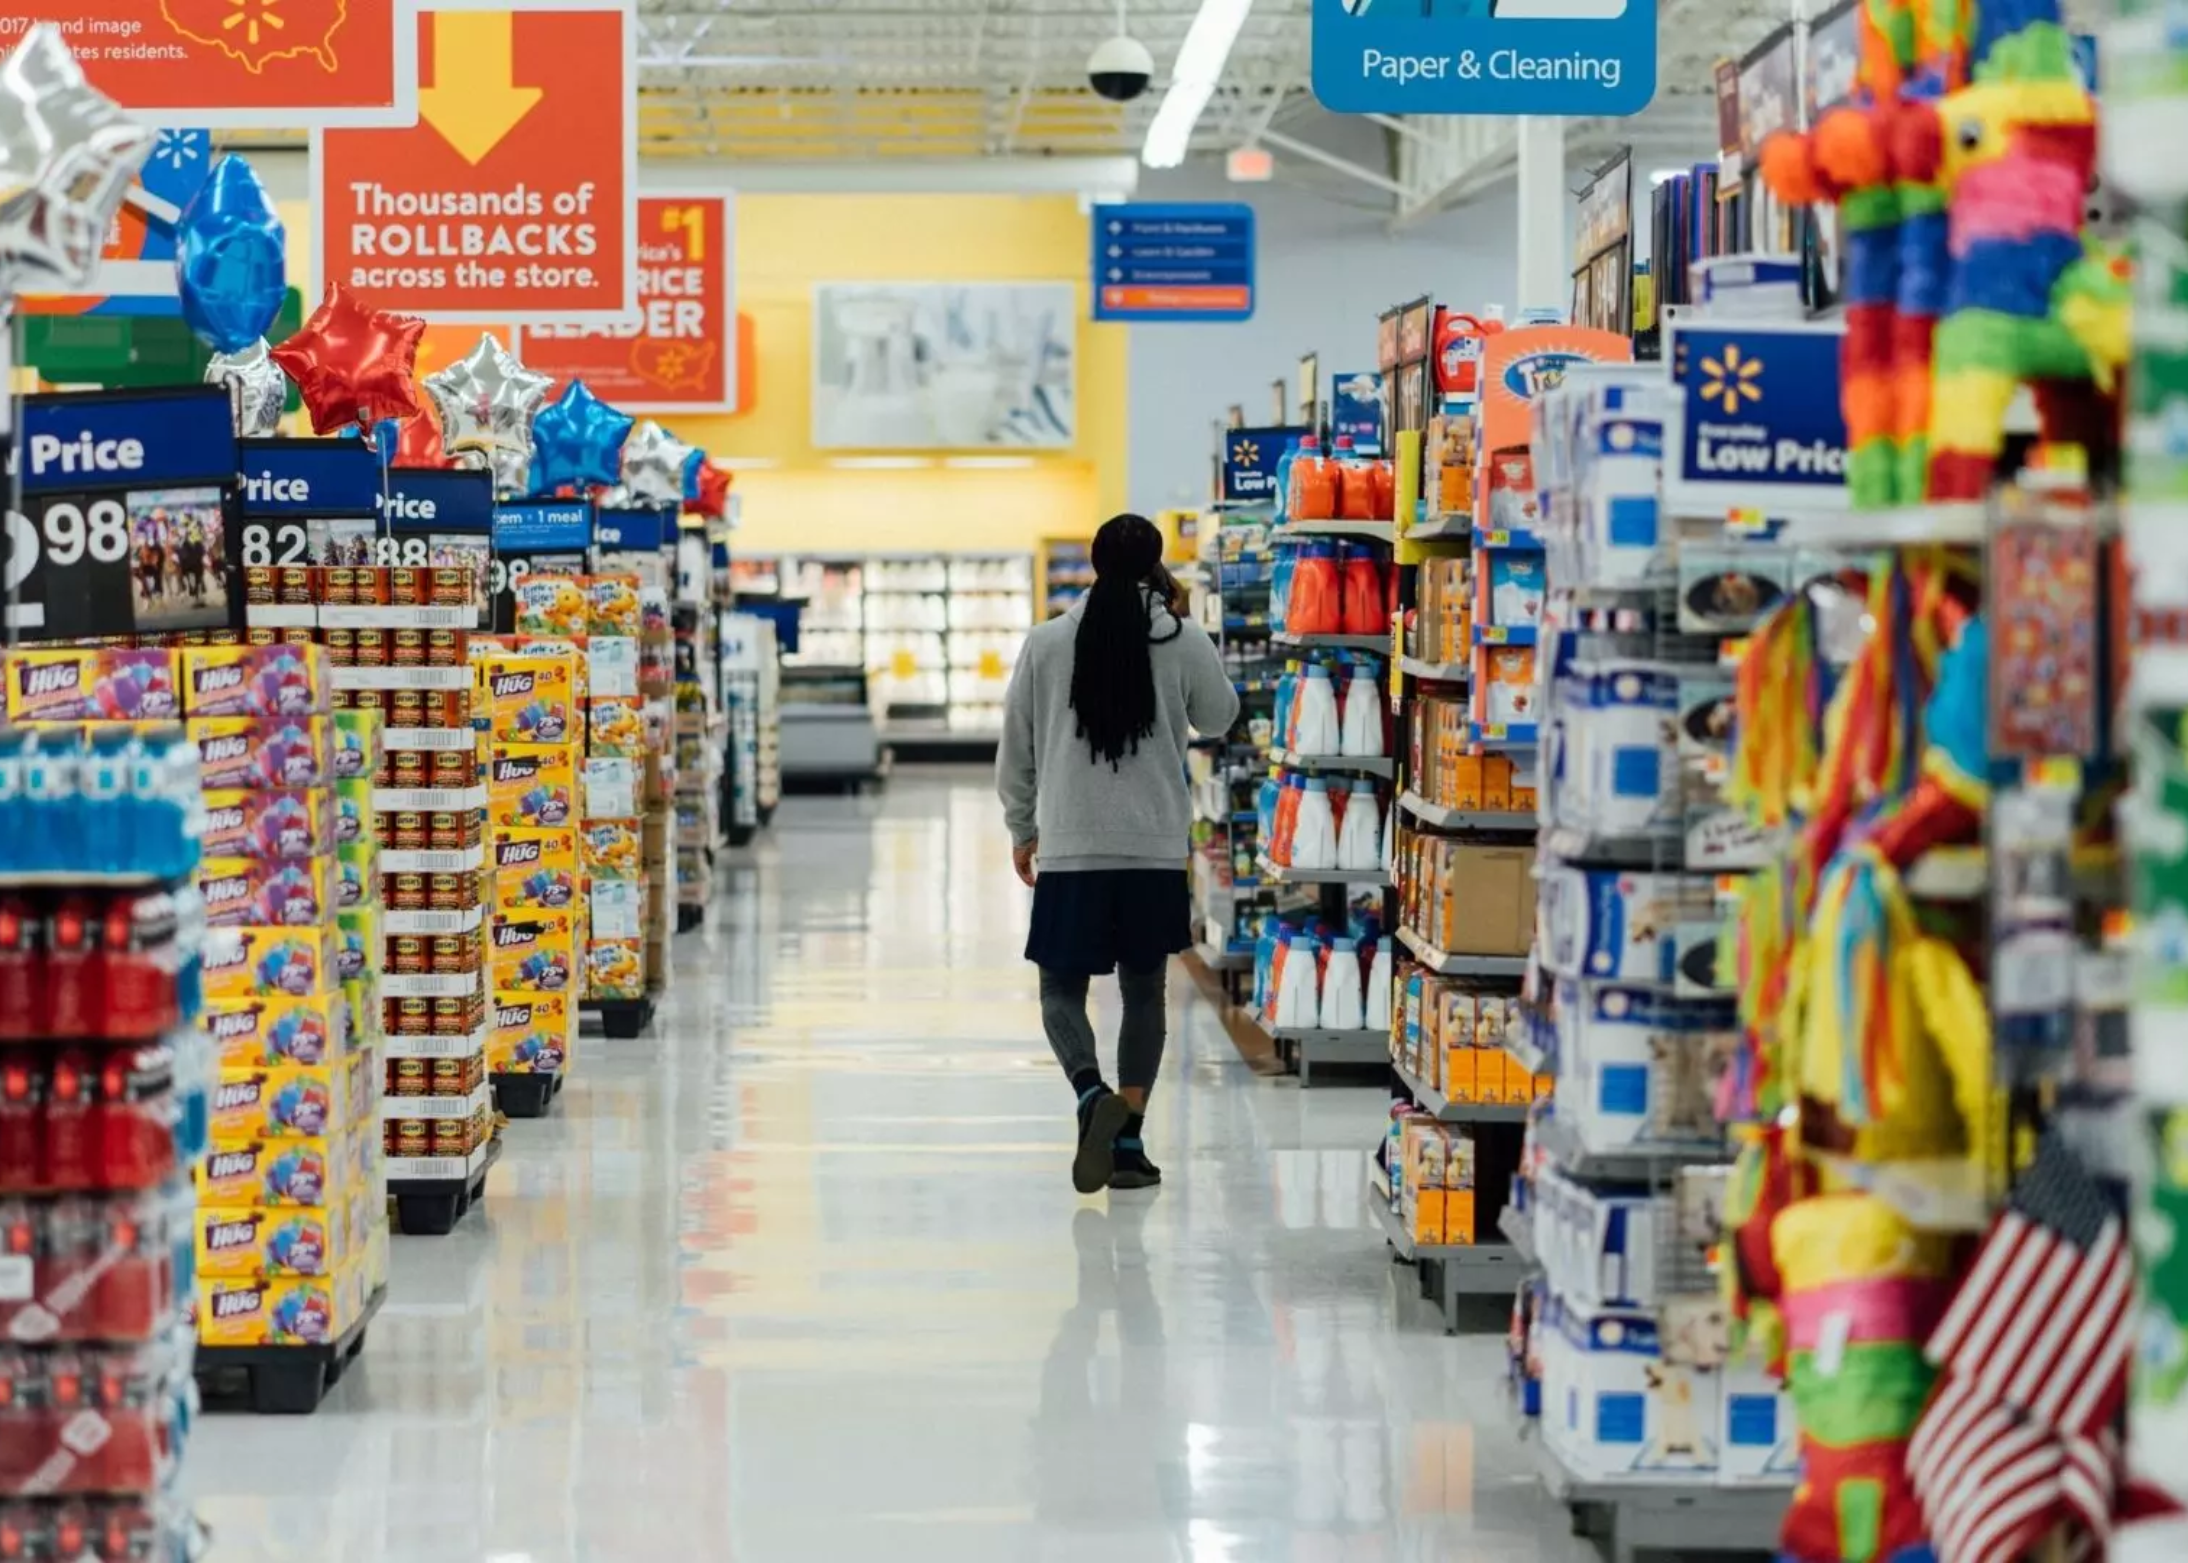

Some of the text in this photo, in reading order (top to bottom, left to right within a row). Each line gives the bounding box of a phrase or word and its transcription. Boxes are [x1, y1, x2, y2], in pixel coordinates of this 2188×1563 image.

[90, 18, 141, 37] image
[104, 44, 188, 59] residents.
[1363, 49, 1621, 88] Paper & Cleaning
[351, 182, 596, 215] Thousands of
[351, 223, 597, 256] ROLLBACKS
[351, 260, 599, 288] across the store.
[30, 430, 145, 474] Price
[1697, 438, 1844, 474] Low Pric
[548, 509, 583, 522] meal
[44, 501, 128, 565] 98
[242, 525, 307, 567] 82
[377, 538, 427, 567] 88
[496, 676, 533, 696] HUG
[502, 845, 539, 864] HUG
